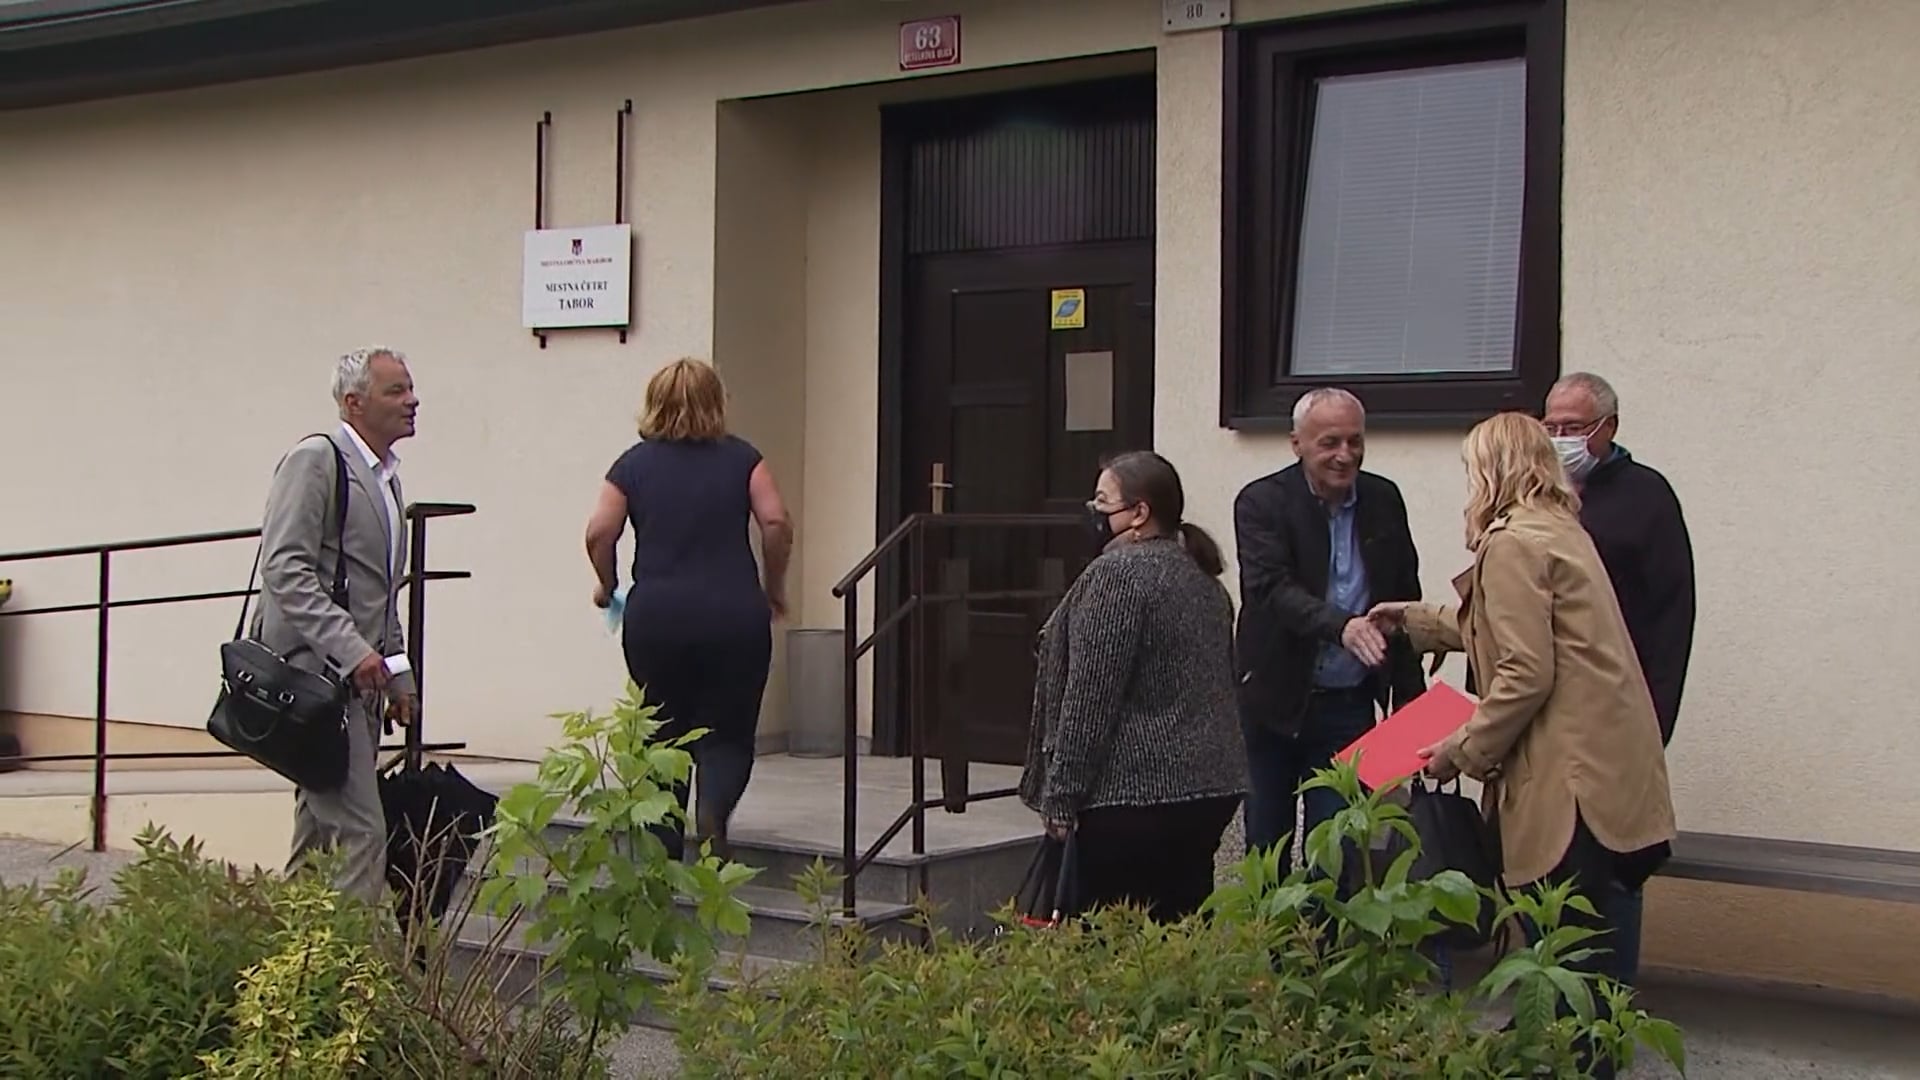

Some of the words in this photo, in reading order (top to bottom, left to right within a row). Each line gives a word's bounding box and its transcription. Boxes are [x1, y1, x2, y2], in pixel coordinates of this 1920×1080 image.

[916, 25, 941, 50] 63
[546, 282, 579, 292] MESTNA
[580, 280, 607, 291] ČETRT
[558, 297, 594, 310] TABOR
